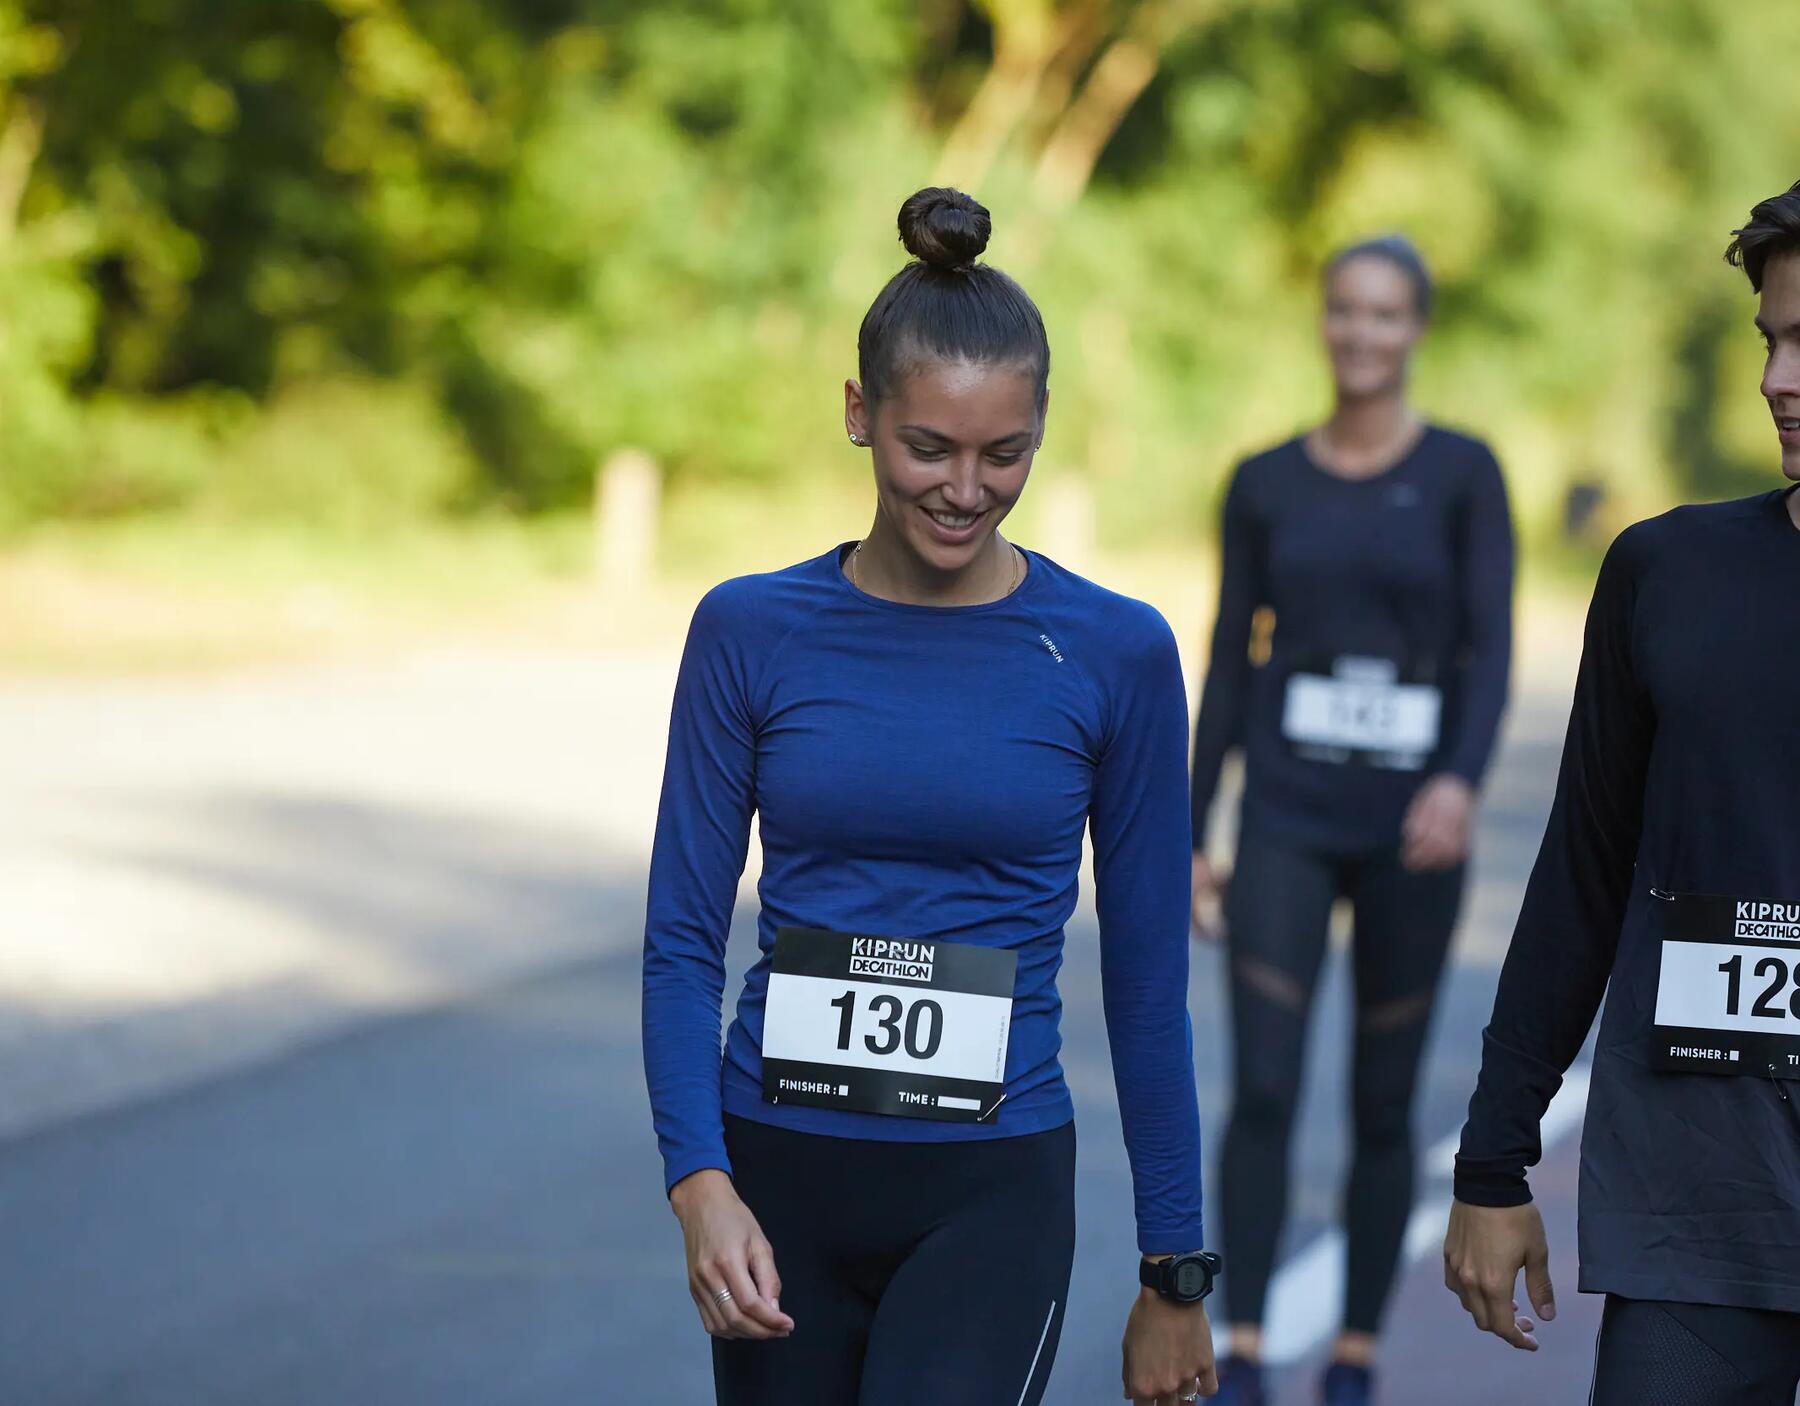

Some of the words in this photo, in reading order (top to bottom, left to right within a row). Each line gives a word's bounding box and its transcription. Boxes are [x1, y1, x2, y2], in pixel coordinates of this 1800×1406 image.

[1040, 634, 1064, 663] KIPRUN
[851, 938, 935, 963] KIPRUN
[853, 958, 929, 980] DECATHLON
[1718, 955, 1800, 1020] 12
[831, 990, 943, 1060] 130
